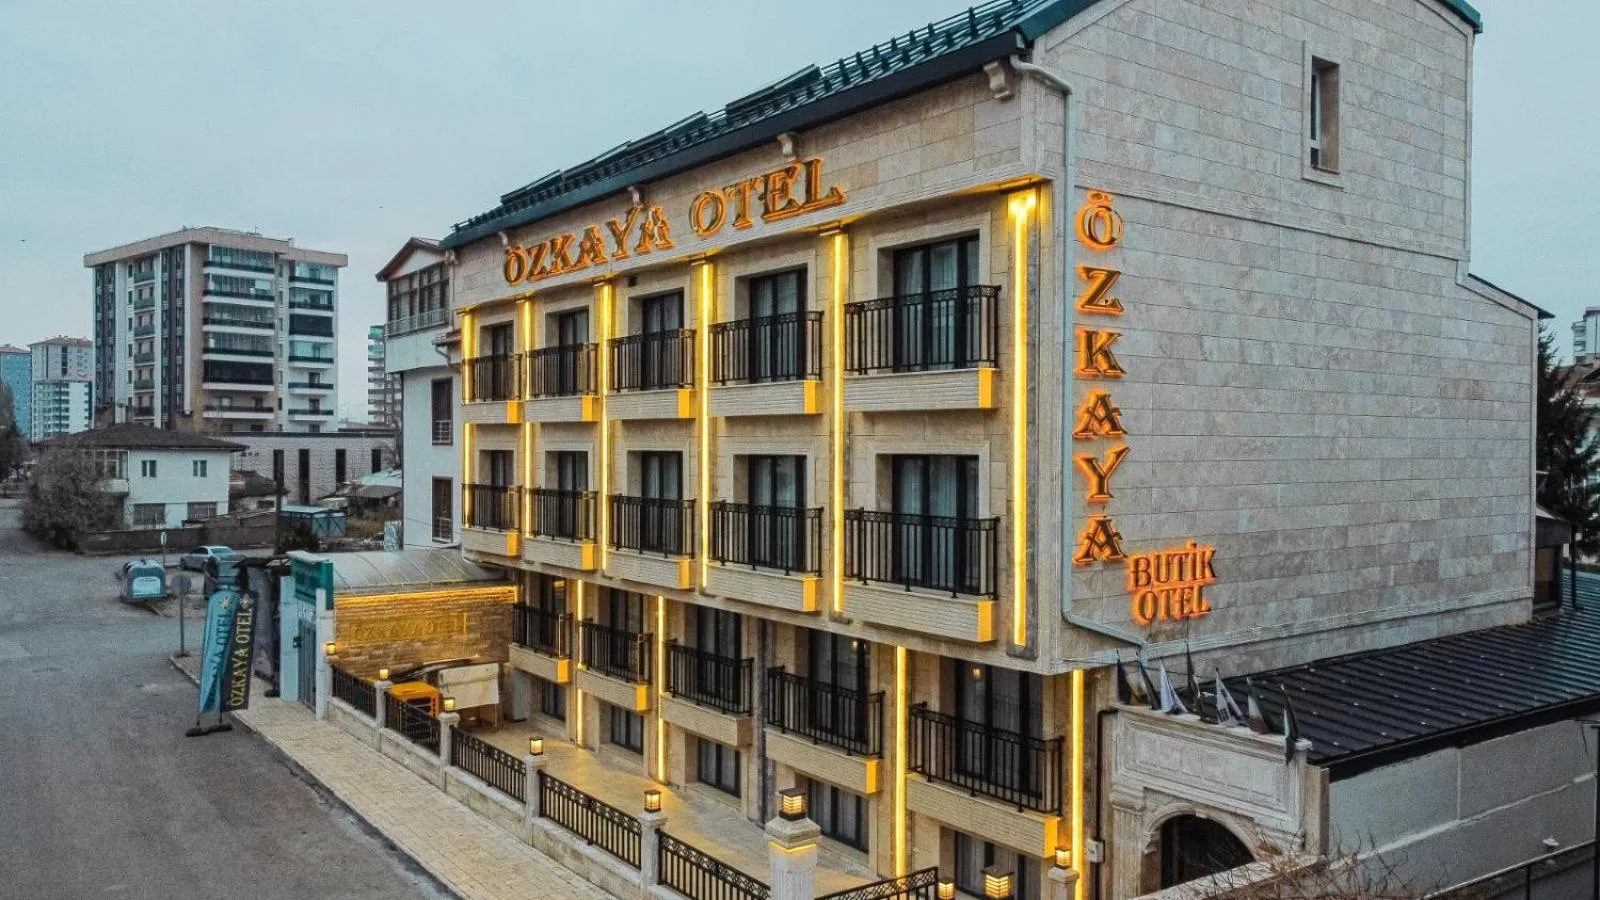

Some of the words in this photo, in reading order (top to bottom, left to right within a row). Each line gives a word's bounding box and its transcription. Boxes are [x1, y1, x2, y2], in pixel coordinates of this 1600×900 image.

[504, 207, 673, 286] ÖZKAYA
[689, 157, 846, 239] OTEL
[1073, 189, 1128, 566] ÖZKAYA
[1126, 540, 1216, 591] BUTİK
[235, 608, 253, 644] OTEL
[1133, 583, 1211, 626] OTEL
